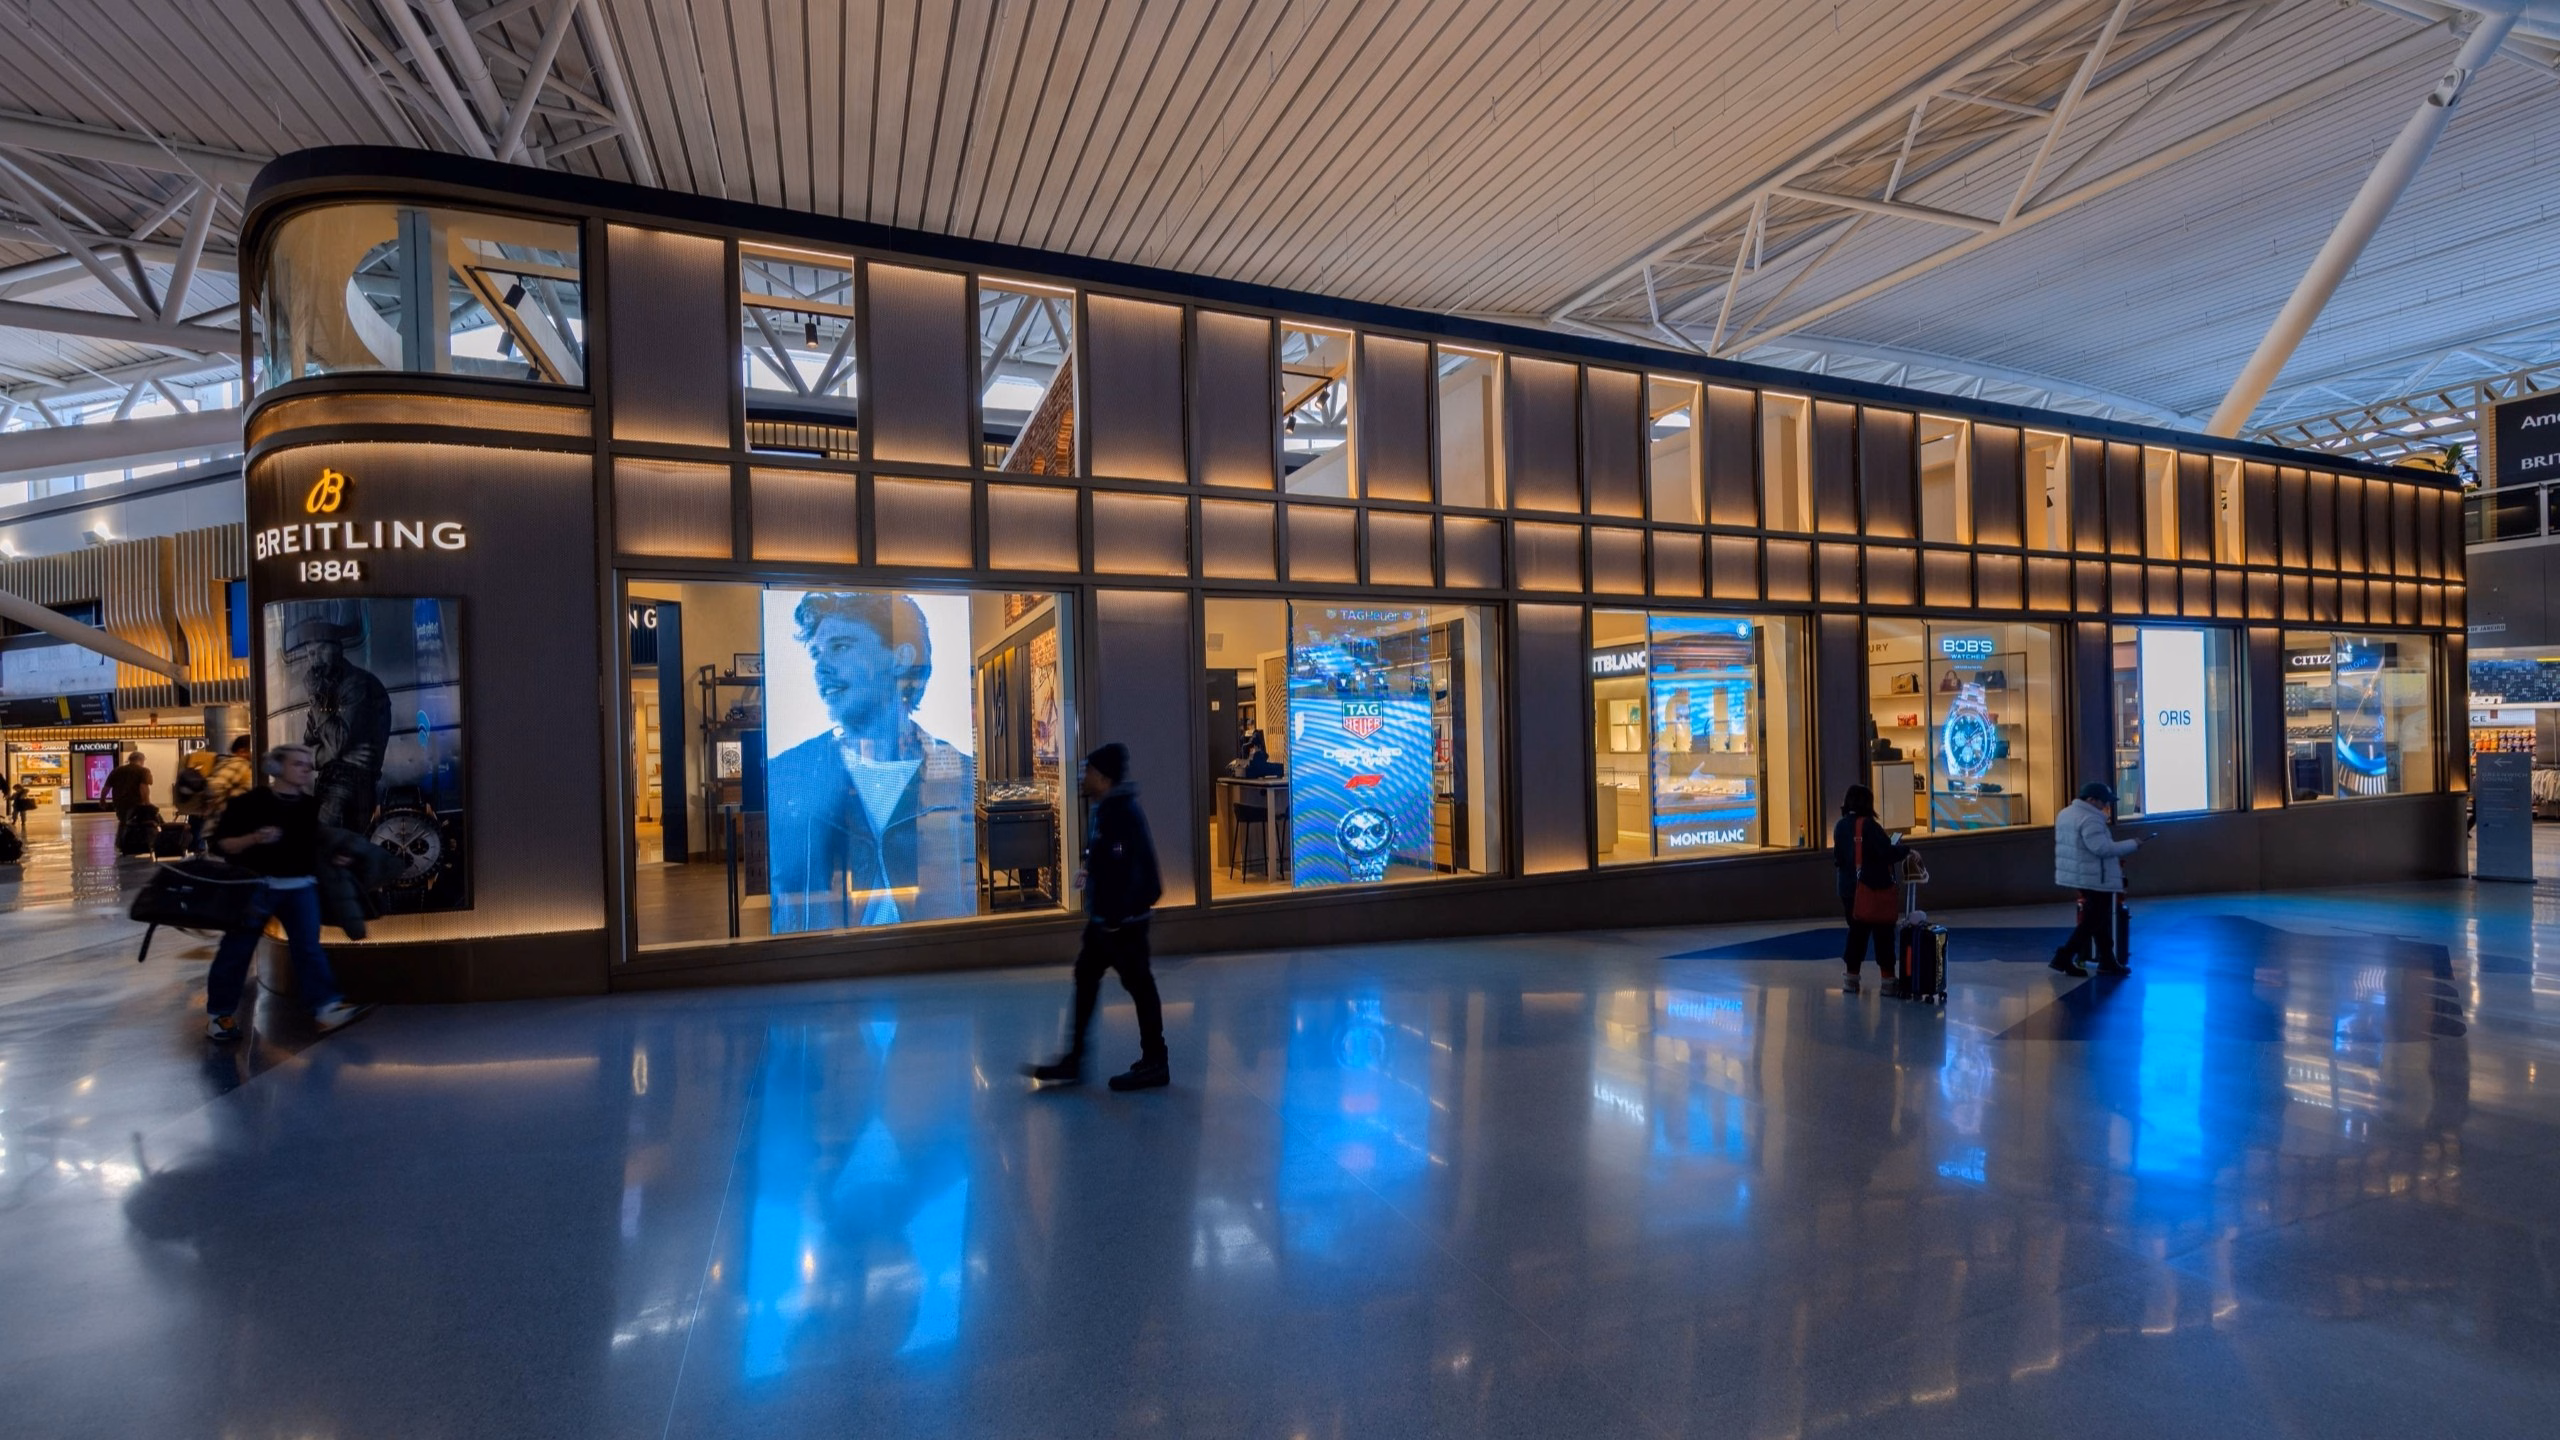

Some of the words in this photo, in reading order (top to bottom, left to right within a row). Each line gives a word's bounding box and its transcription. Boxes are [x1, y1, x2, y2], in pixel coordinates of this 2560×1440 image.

[256, 520, 466, 560] BREITLING
[300, 560, 361, 583] 1884
[1943, 640, 1993, 652] BOB'S
[1346, 704, 1379, 716] TAG
[2159, 710, 2191, 726] ORIS
[1345, 717, 1381, 737] HEUER
[74, 742, 112, 751] LANCÔME
[1670, 828, 1744, 846] MONTBLANC
